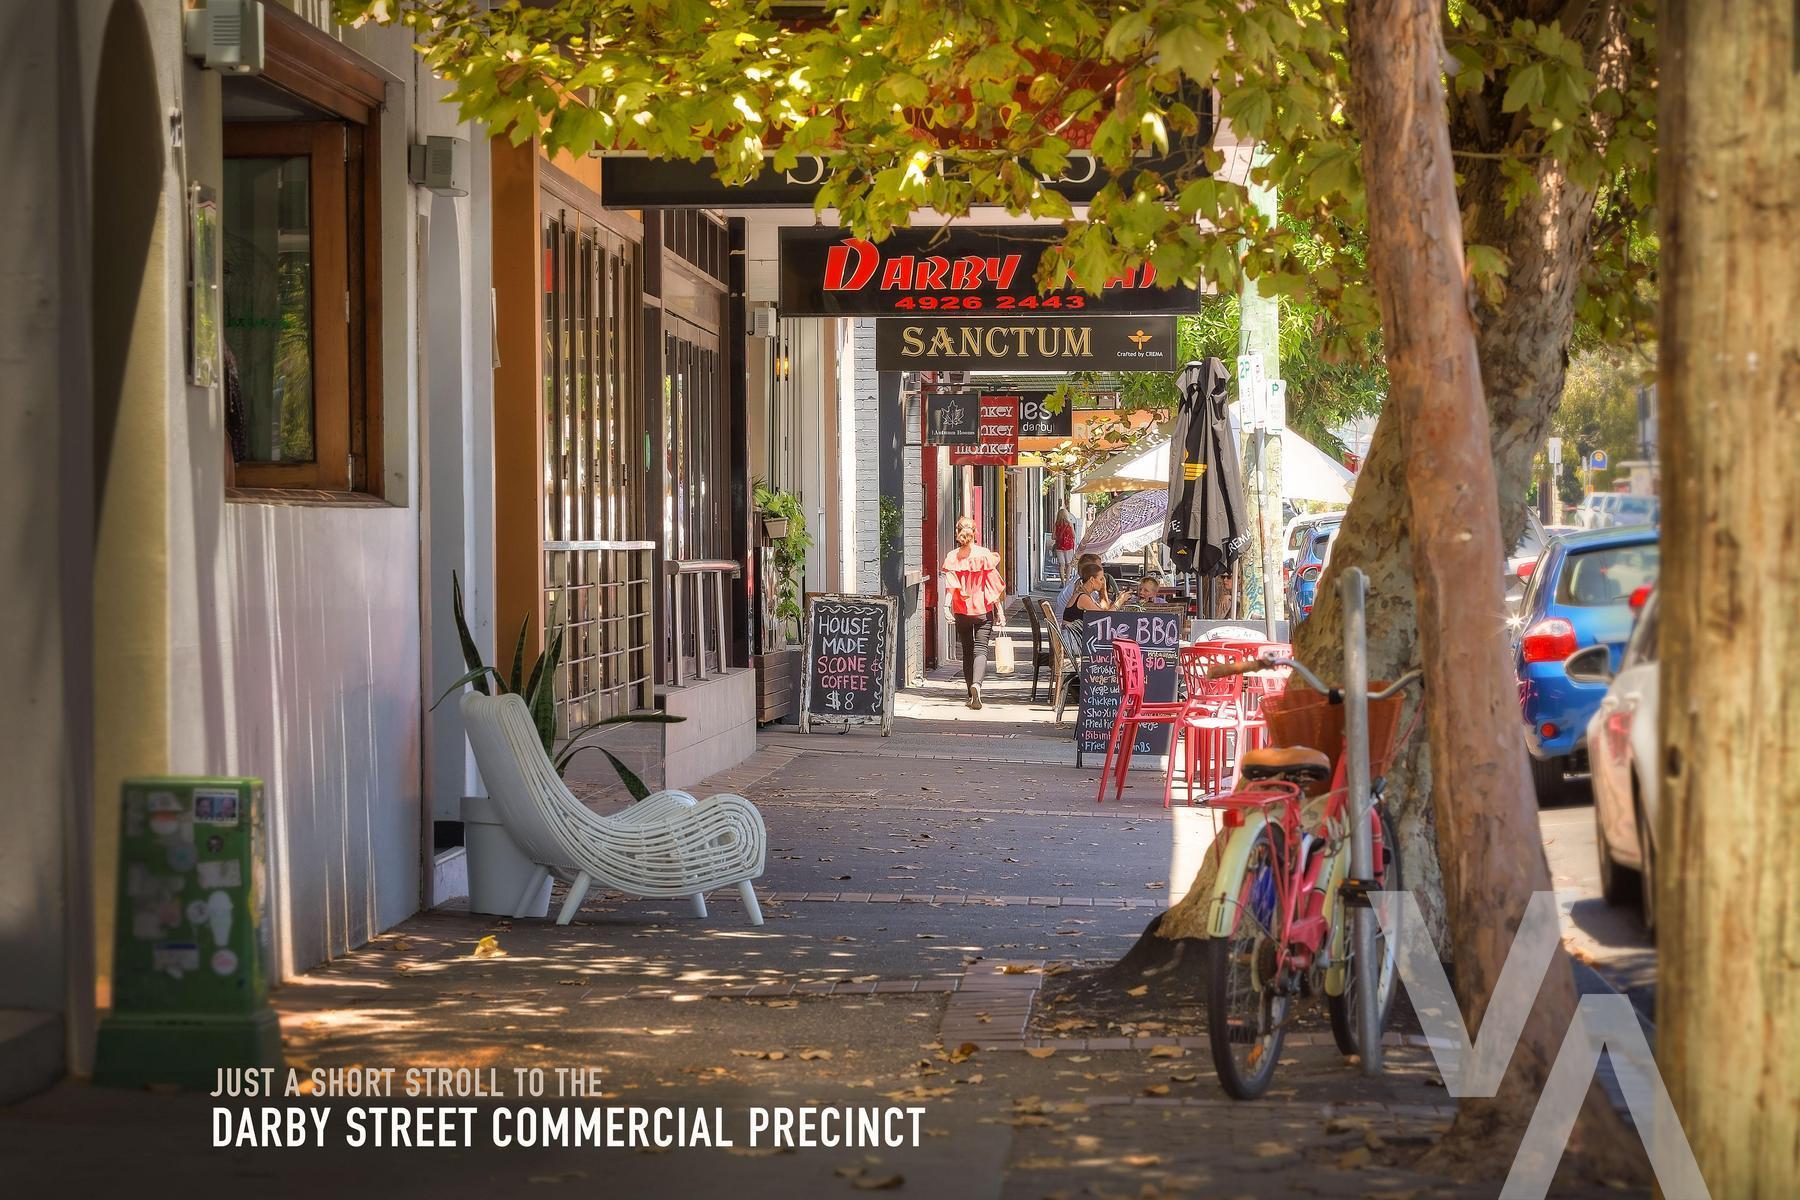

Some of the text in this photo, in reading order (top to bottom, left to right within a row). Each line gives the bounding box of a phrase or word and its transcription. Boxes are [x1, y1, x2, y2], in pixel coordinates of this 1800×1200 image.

[822, 237, 1023, 291] DARBY
[894, 294, 1086, 311] 4926 2443
[901, 325, 1094, 358] SANCTUM
[1022, 421, 1053, 434] darby
[818, 615, 873, 635] HOUSE
[1087, 616, 1179, 647] The BBQ
[822, 636, 869, 655] MADE
[817, 655, 868, 674] SCONE
[1144, 656, 1166, 672] $10
[821, 674, 870, 691] COFFEE
[1085, 741, 1106, 752] Fried
